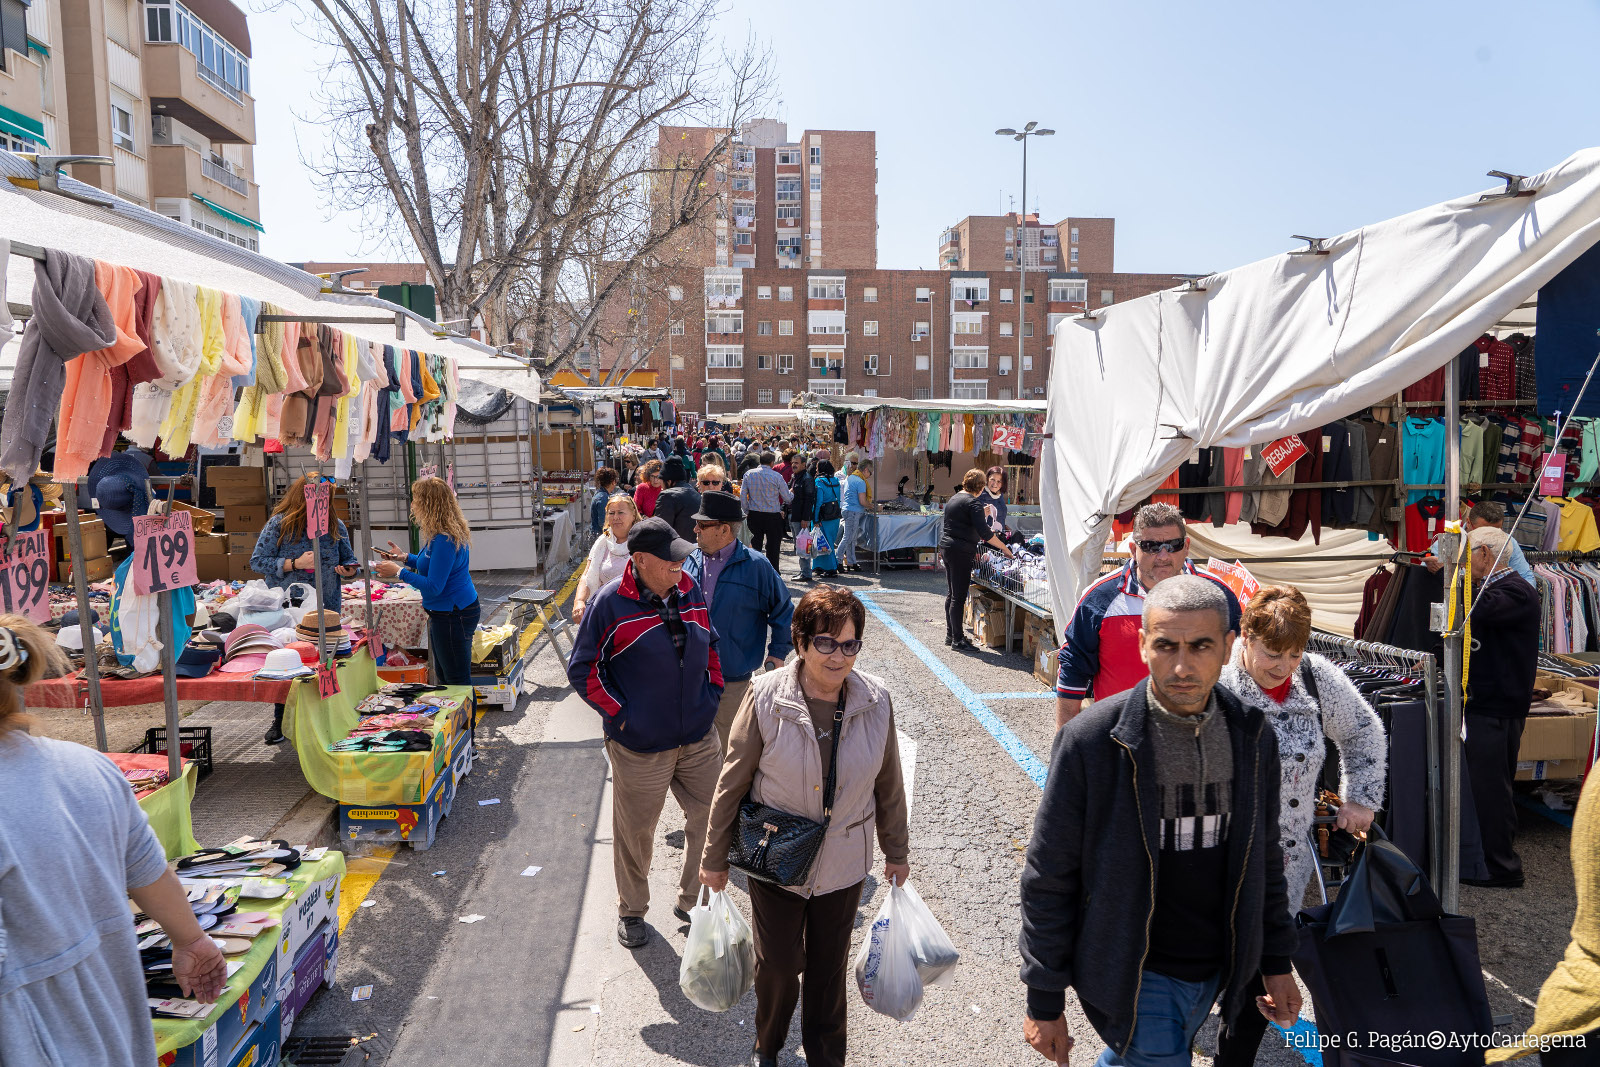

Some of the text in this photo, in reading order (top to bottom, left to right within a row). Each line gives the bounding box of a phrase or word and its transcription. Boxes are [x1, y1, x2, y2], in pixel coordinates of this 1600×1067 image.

[1265, 434, 1302, 470] REBAJAS
[143, 530, 189, 594] 1'99
[171, 572, 180, 584] €
[351, 810, 397, 819] Guanchita
[299, 884, 321, 921] VEREDA
[307, 911, 314, 931] LA
